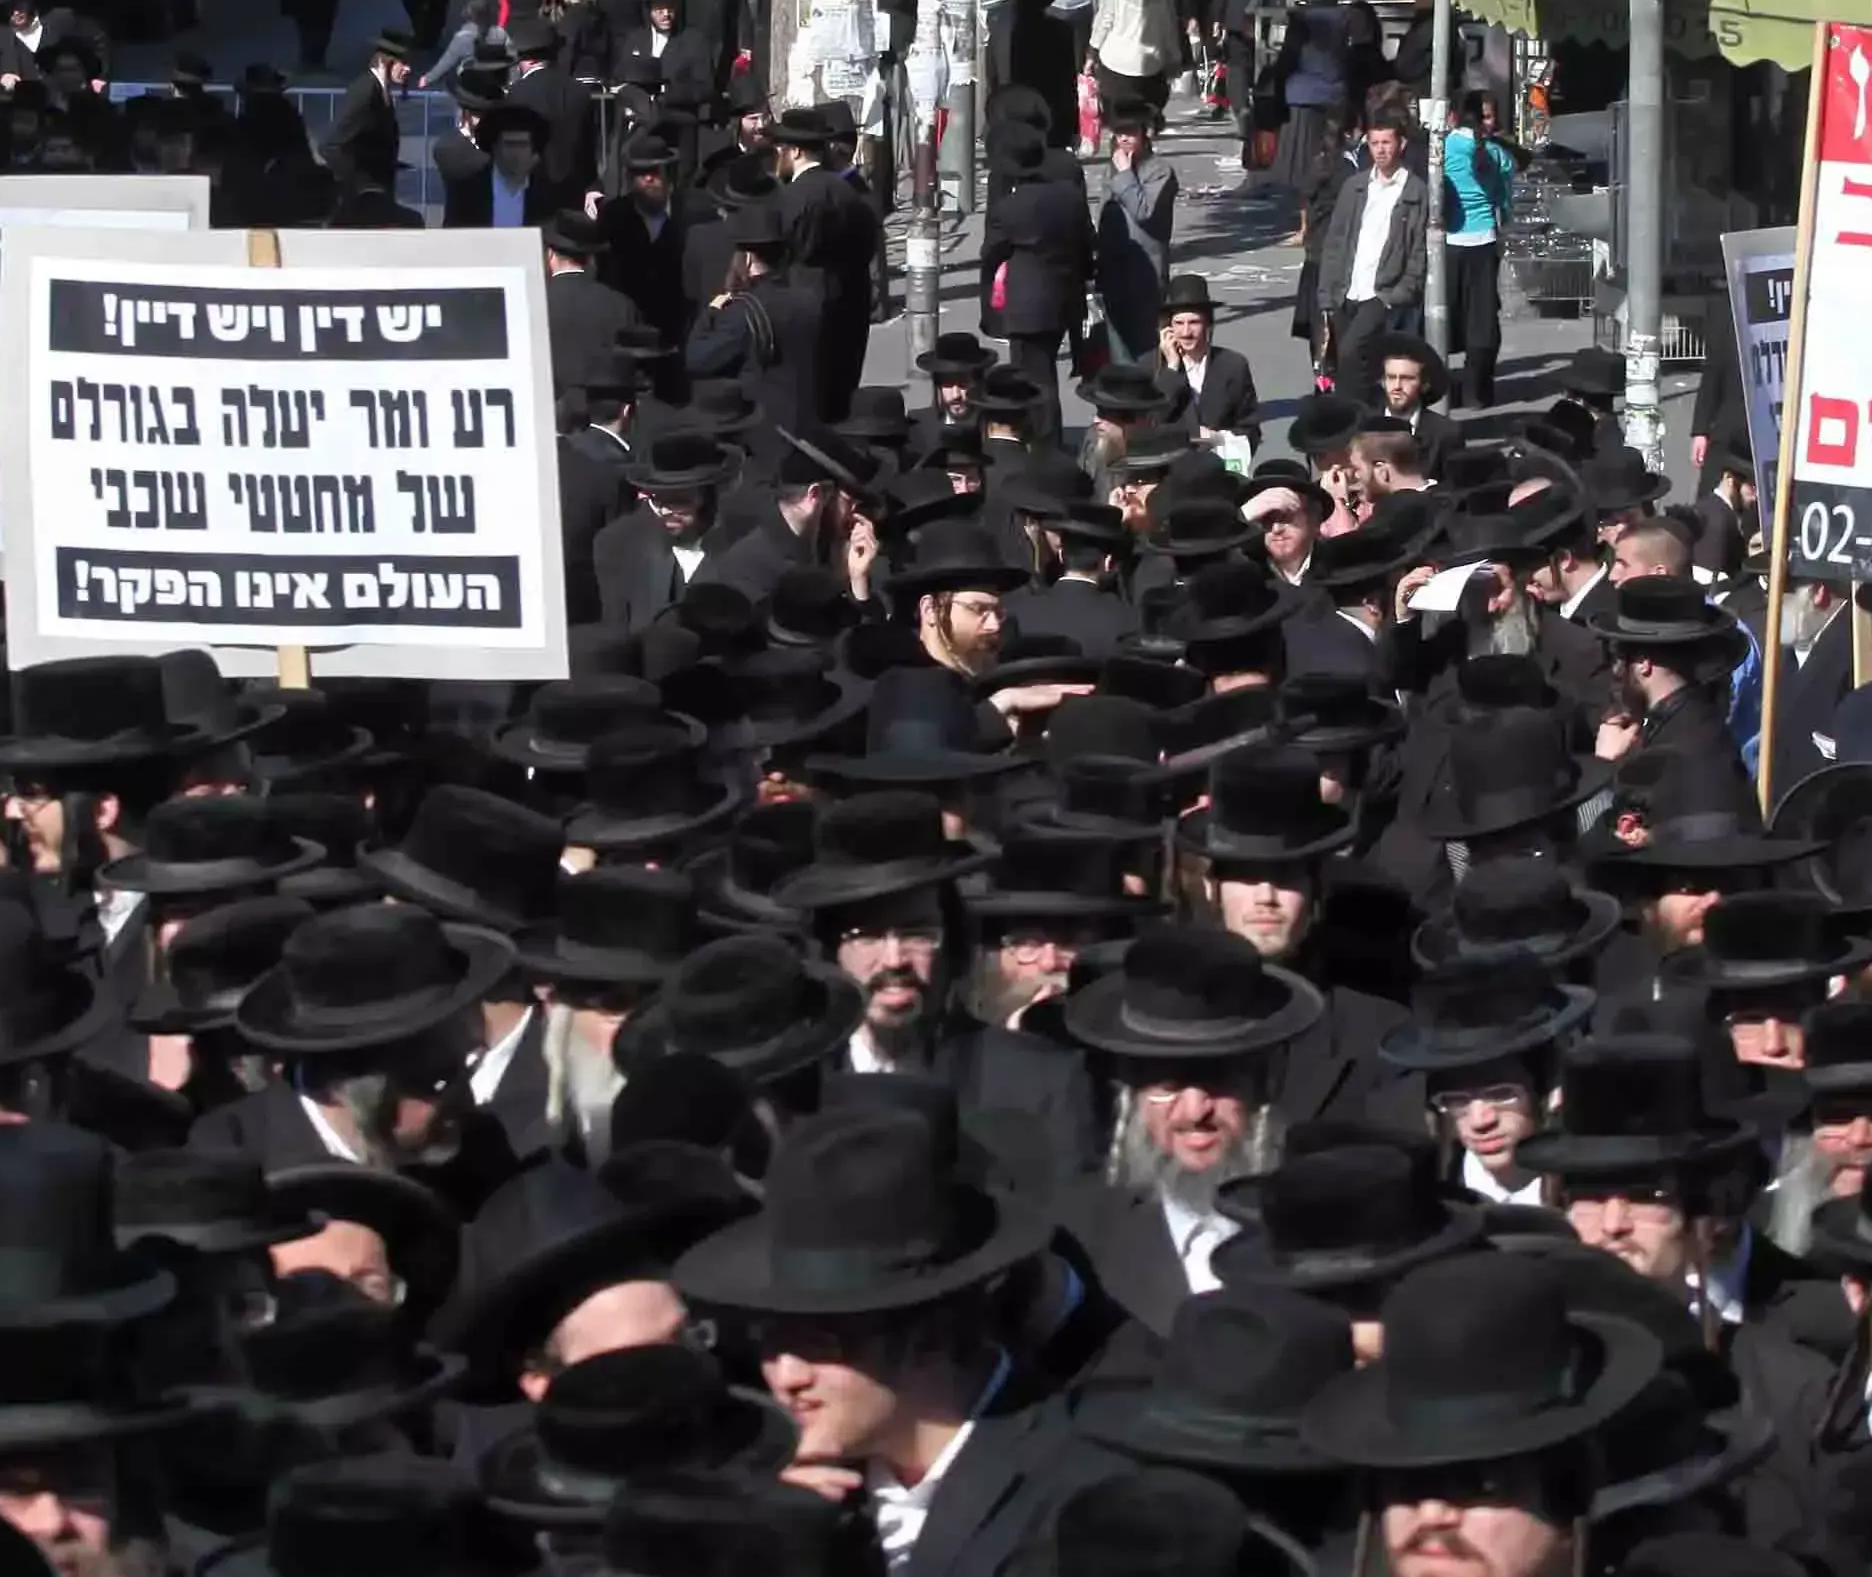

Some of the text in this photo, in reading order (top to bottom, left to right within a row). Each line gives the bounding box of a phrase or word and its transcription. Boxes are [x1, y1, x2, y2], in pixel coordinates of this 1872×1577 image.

[102, 293, 442, 352] יש דין ויש דיין!
[50, 376, 517, 449] רע ומר יעלה בגורלם
[90, 467, 477, 534] של מחטטי שכבי
[73, 559, 502, 615] העולם אינו הפקר!
